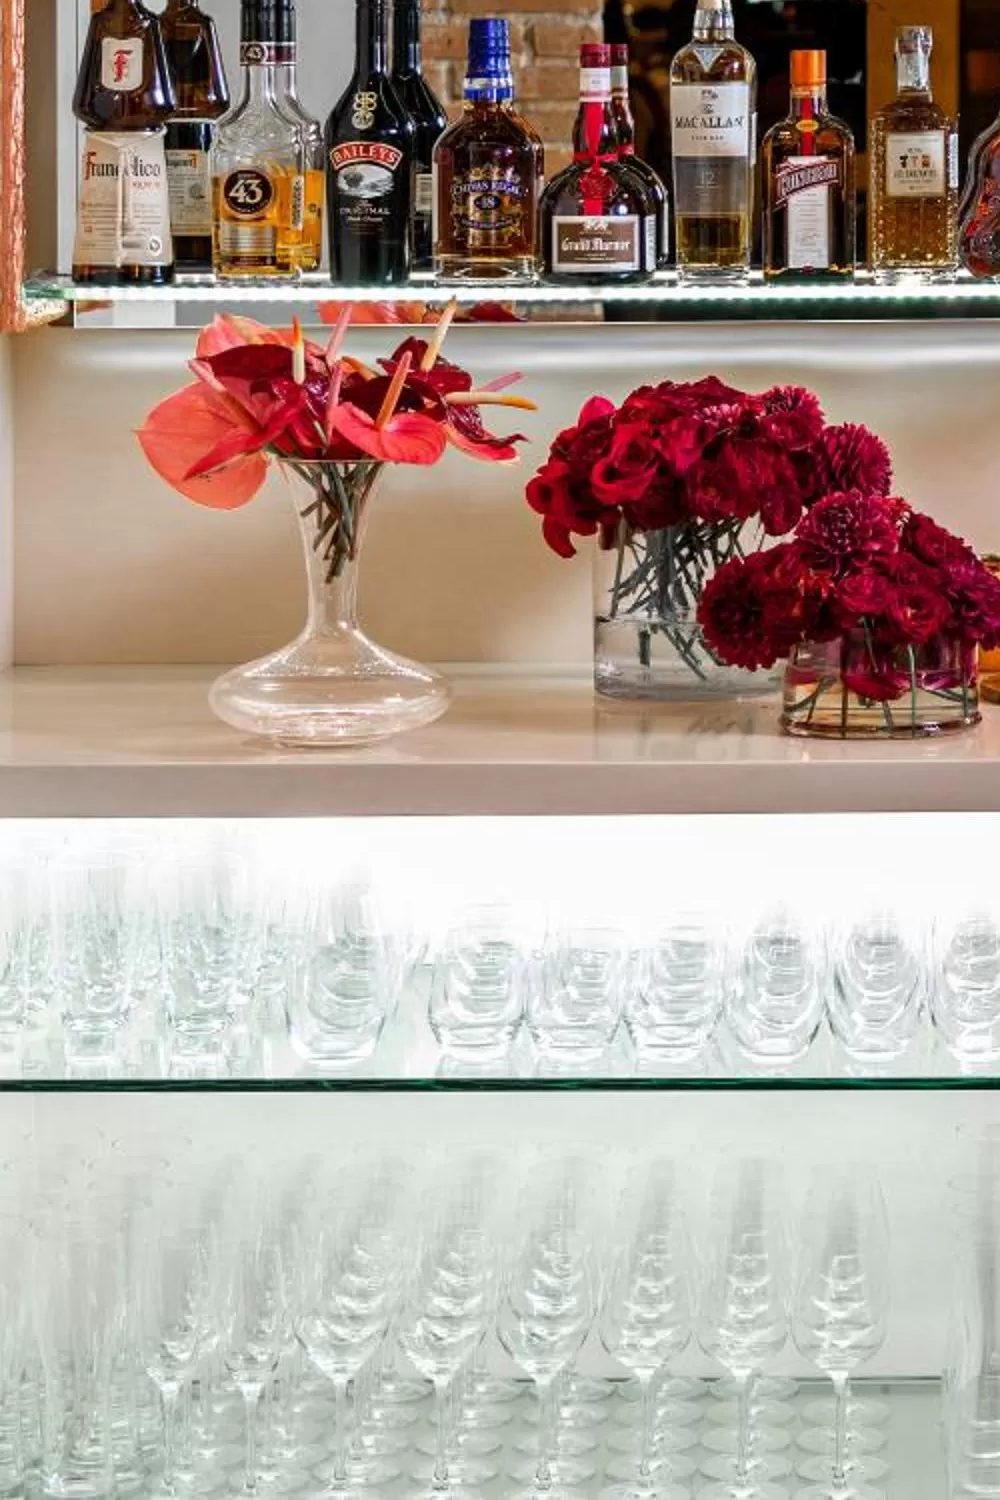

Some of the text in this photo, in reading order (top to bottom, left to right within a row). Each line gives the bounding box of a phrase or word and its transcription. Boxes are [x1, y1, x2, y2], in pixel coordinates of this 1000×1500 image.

[674, 115, 744, 130] MACALLAN
[334, 145, 399, 164] BAILEYS
[229, 179, 264, 204] 43
[561, 237, 590, 252] Grand
